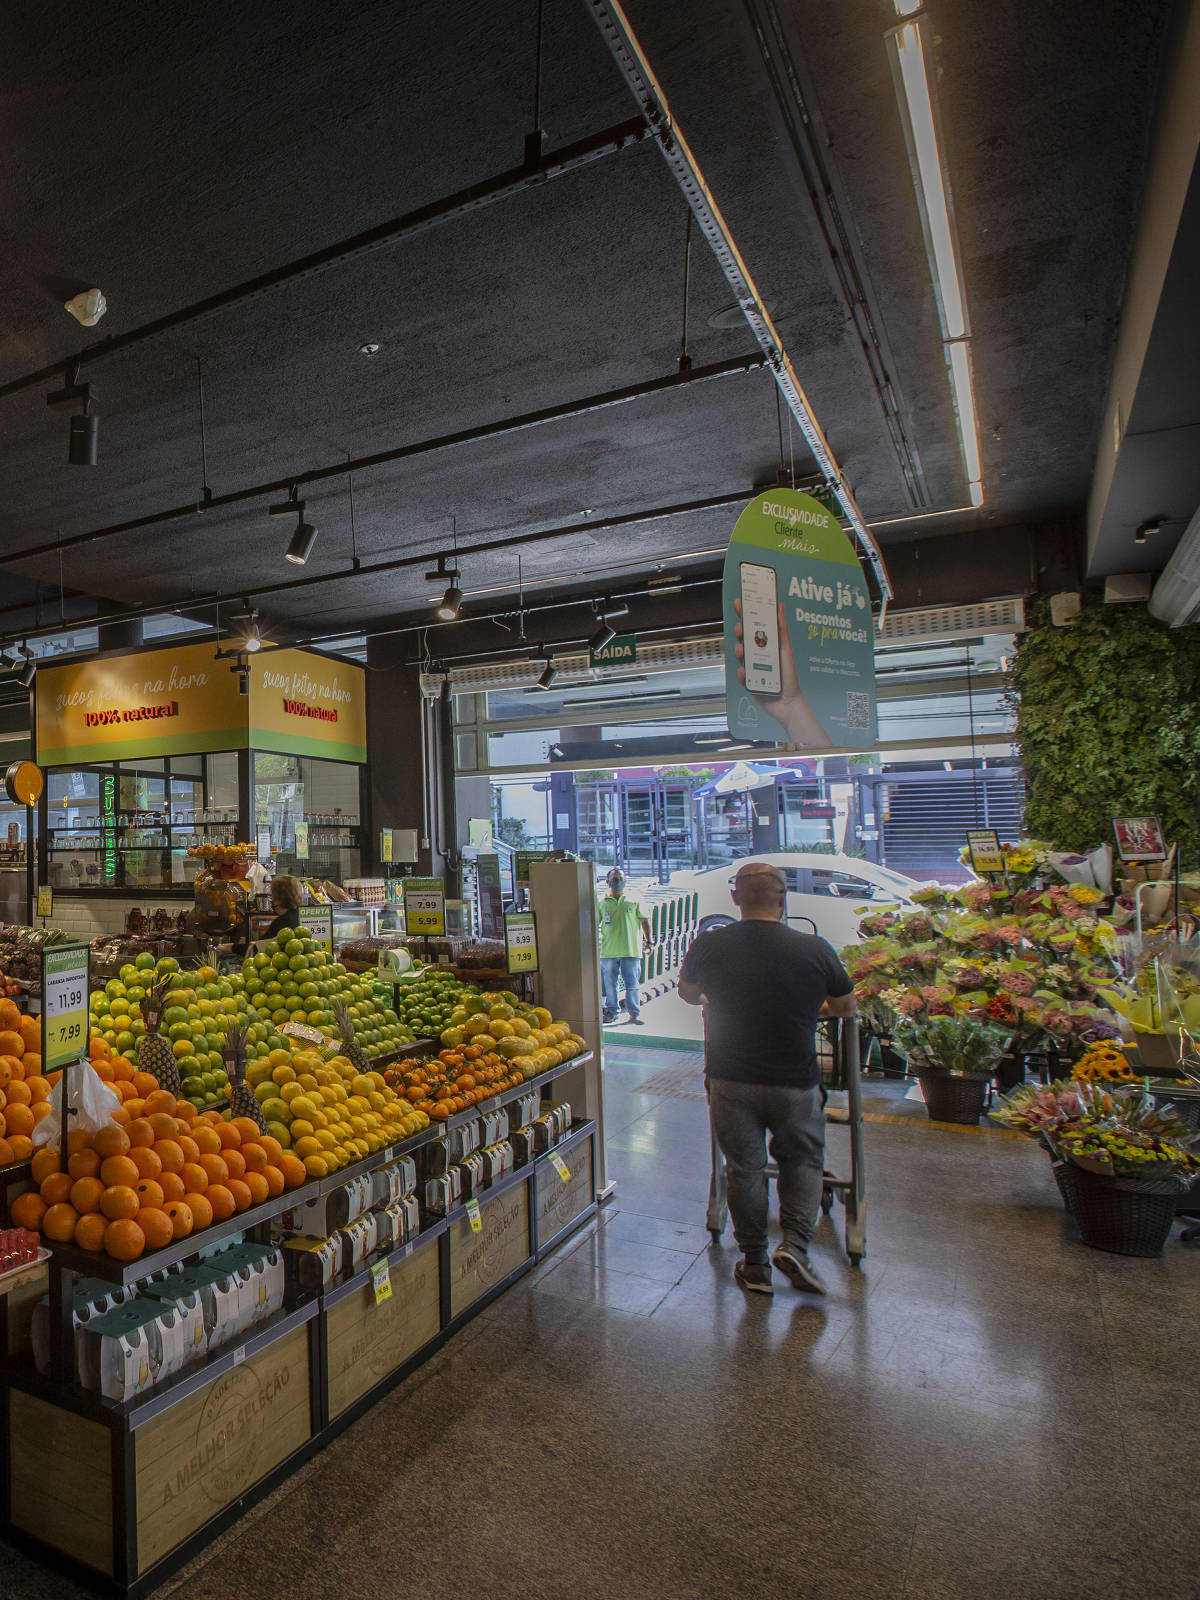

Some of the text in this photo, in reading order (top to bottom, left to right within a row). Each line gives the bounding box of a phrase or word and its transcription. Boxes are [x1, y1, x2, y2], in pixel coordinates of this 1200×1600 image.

[762, 501, 829, 529] EXCLUSIVIDADE
[774, 521, 803, 539] Cliente
[788, 576, 853, 610] Ative já
[796, 608, 852, 629] Descontos
[839, 629, 868, 643] você!
[593, 645, 632, 661] SAÍDA
[167, 665, 209, 692] hora
[263, 671, 352, 703] sucos feitos na hora
[83, 701, 179, 727] 100% natural
[284, 699, 338, 723] 100% natural
[417, 901, 437, 910] 7,99
[418, 917, 438, 926] 5,99
[48, 950, 86, 963] EXCLUSIVIDADE
[59, 990, 82, 1009] 11,99
[60, 1023, 81, 1042] 7,99
[163, 1482, 175, 1506] A
[176, 1424, 234, 1491] MELHOR
[237, 1366, 291, 1426] SELEÇÃO
